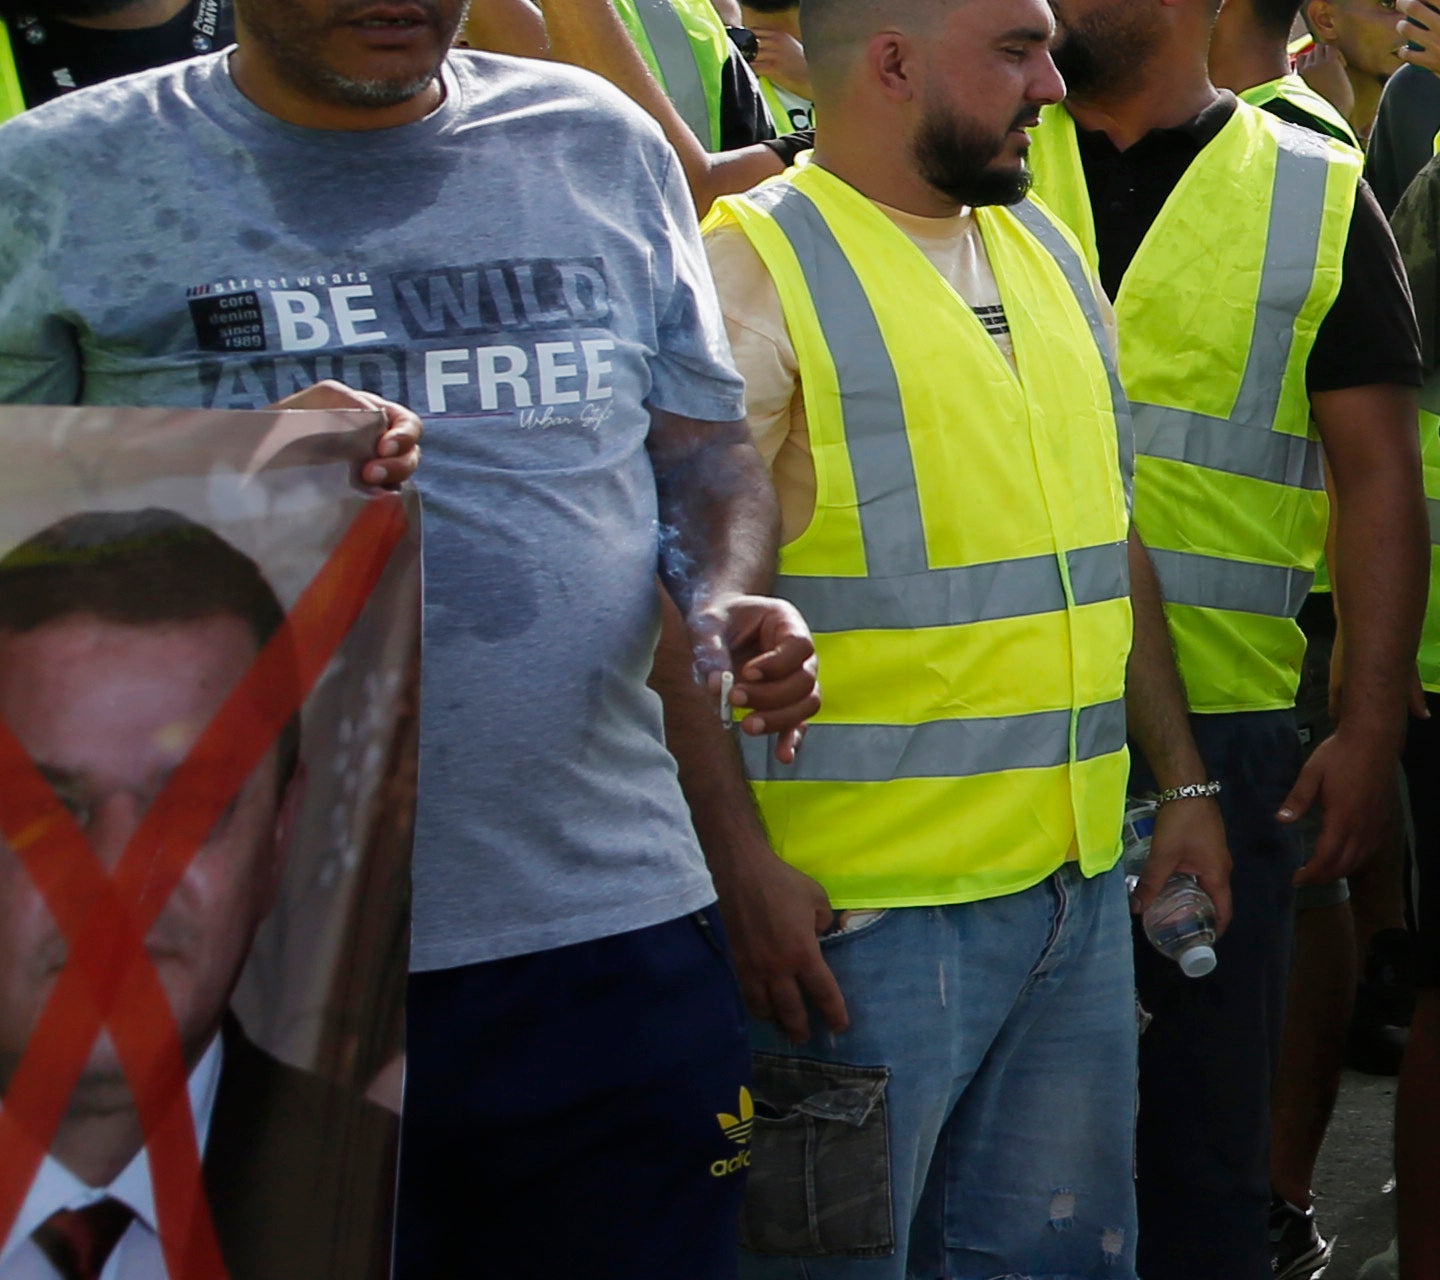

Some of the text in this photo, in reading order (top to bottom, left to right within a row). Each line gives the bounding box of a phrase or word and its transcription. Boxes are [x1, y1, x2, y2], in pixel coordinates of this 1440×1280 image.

[214, 270, 368, 294] street wears
[219, 293, 255, 310] core
[271, 263, 609, 352] BE WILD
[210, 308, 260, 326] denim
[220, 322, 262, 337] since
[424, 339, 616, 414] FREE
